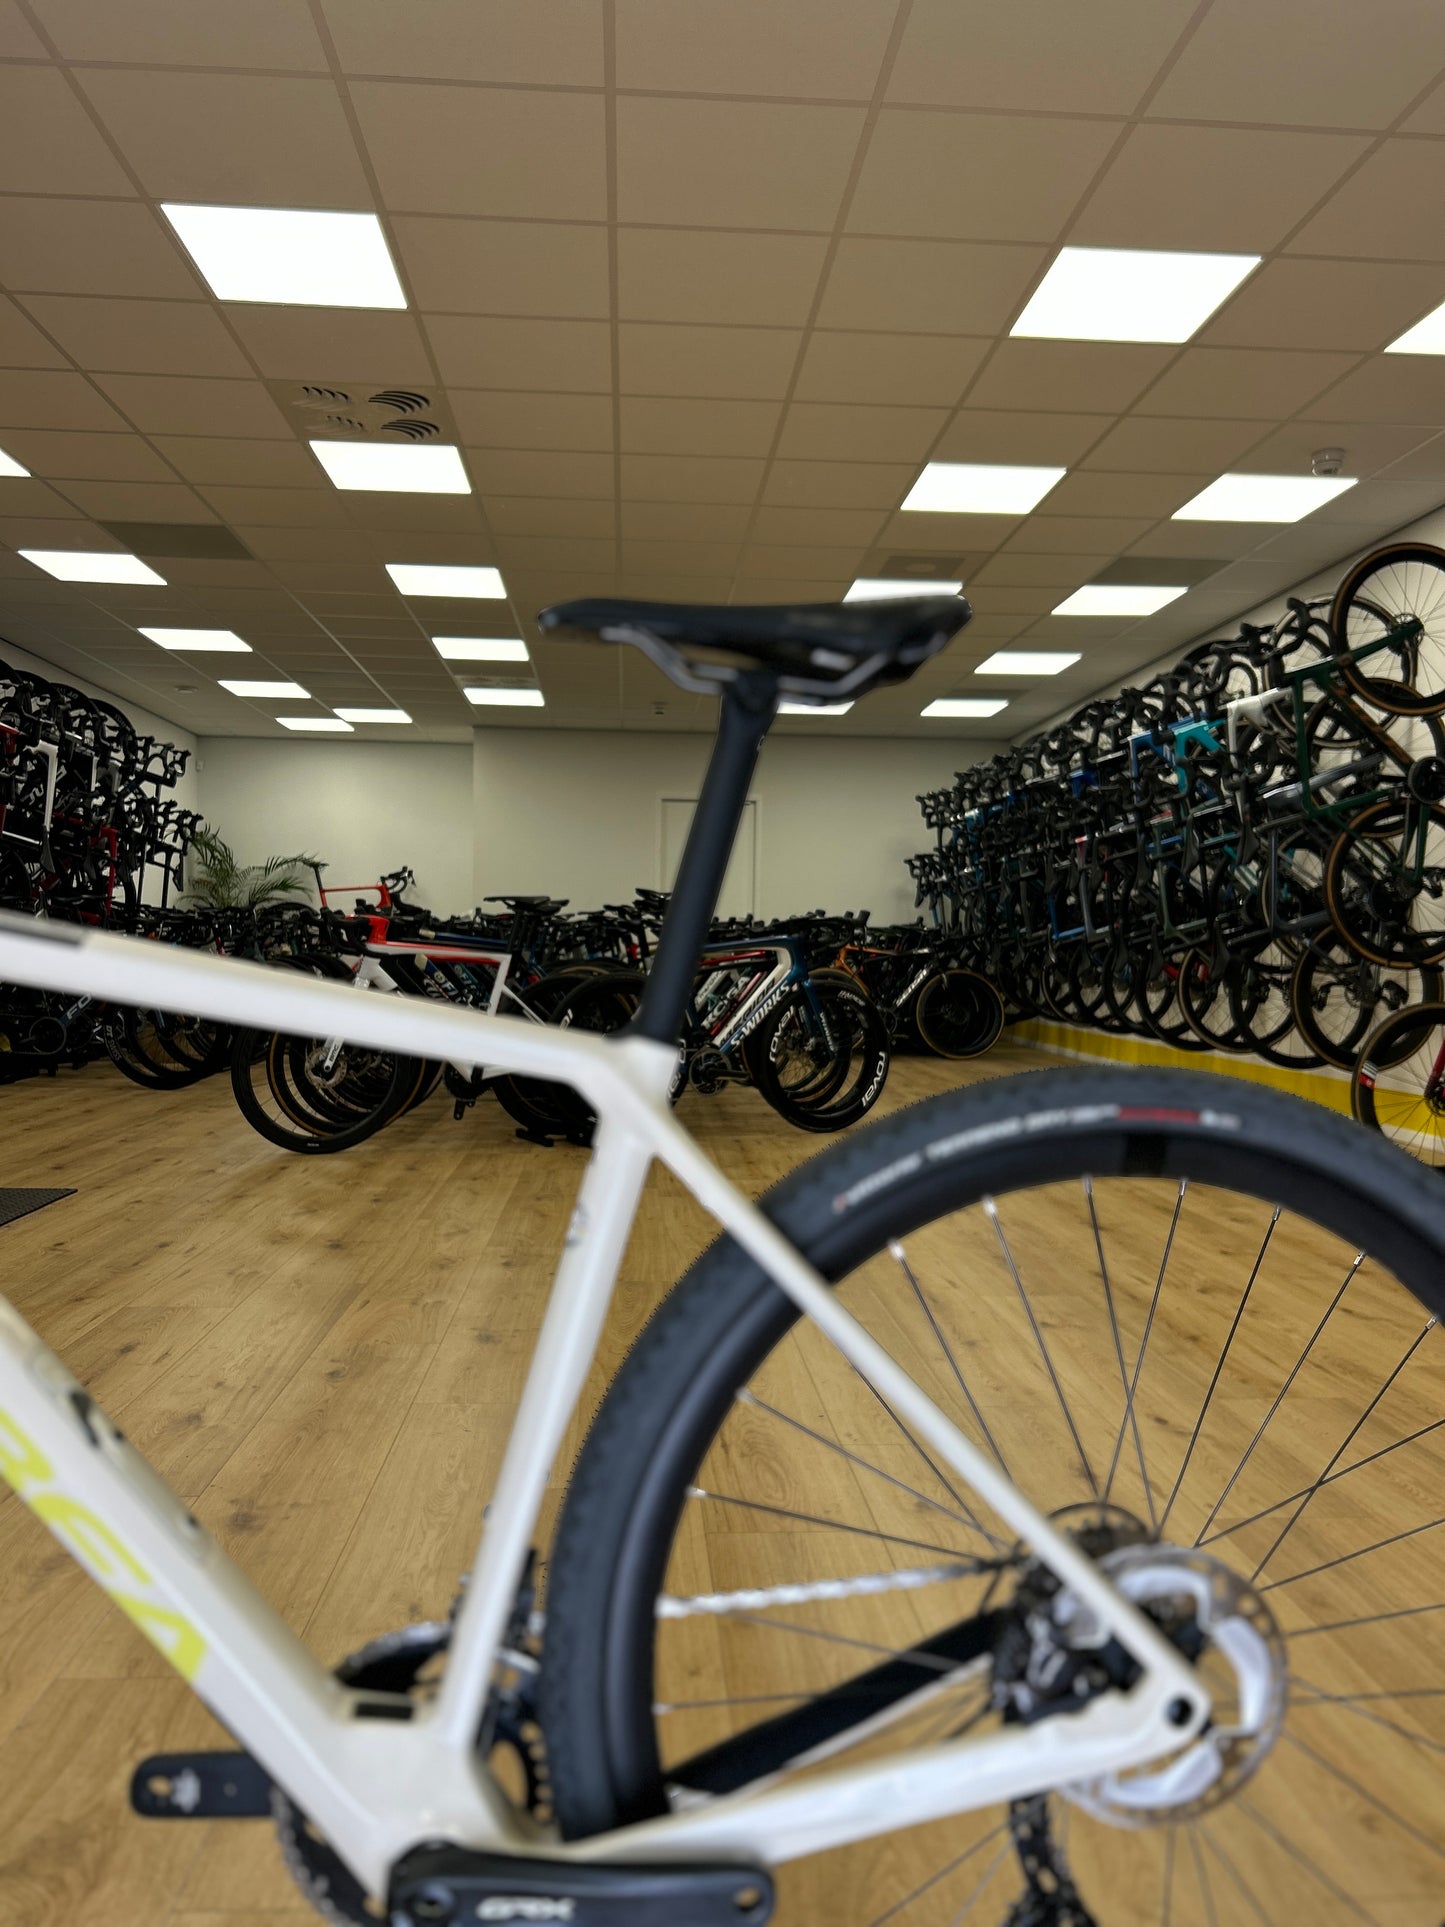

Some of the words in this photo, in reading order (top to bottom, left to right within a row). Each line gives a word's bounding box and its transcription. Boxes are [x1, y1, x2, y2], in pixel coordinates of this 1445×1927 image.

[730, 979, 790, 1052] S-WORKS
[769, 1005, 795, 1063] roval
[861, 1051, 887, 1108] roval
